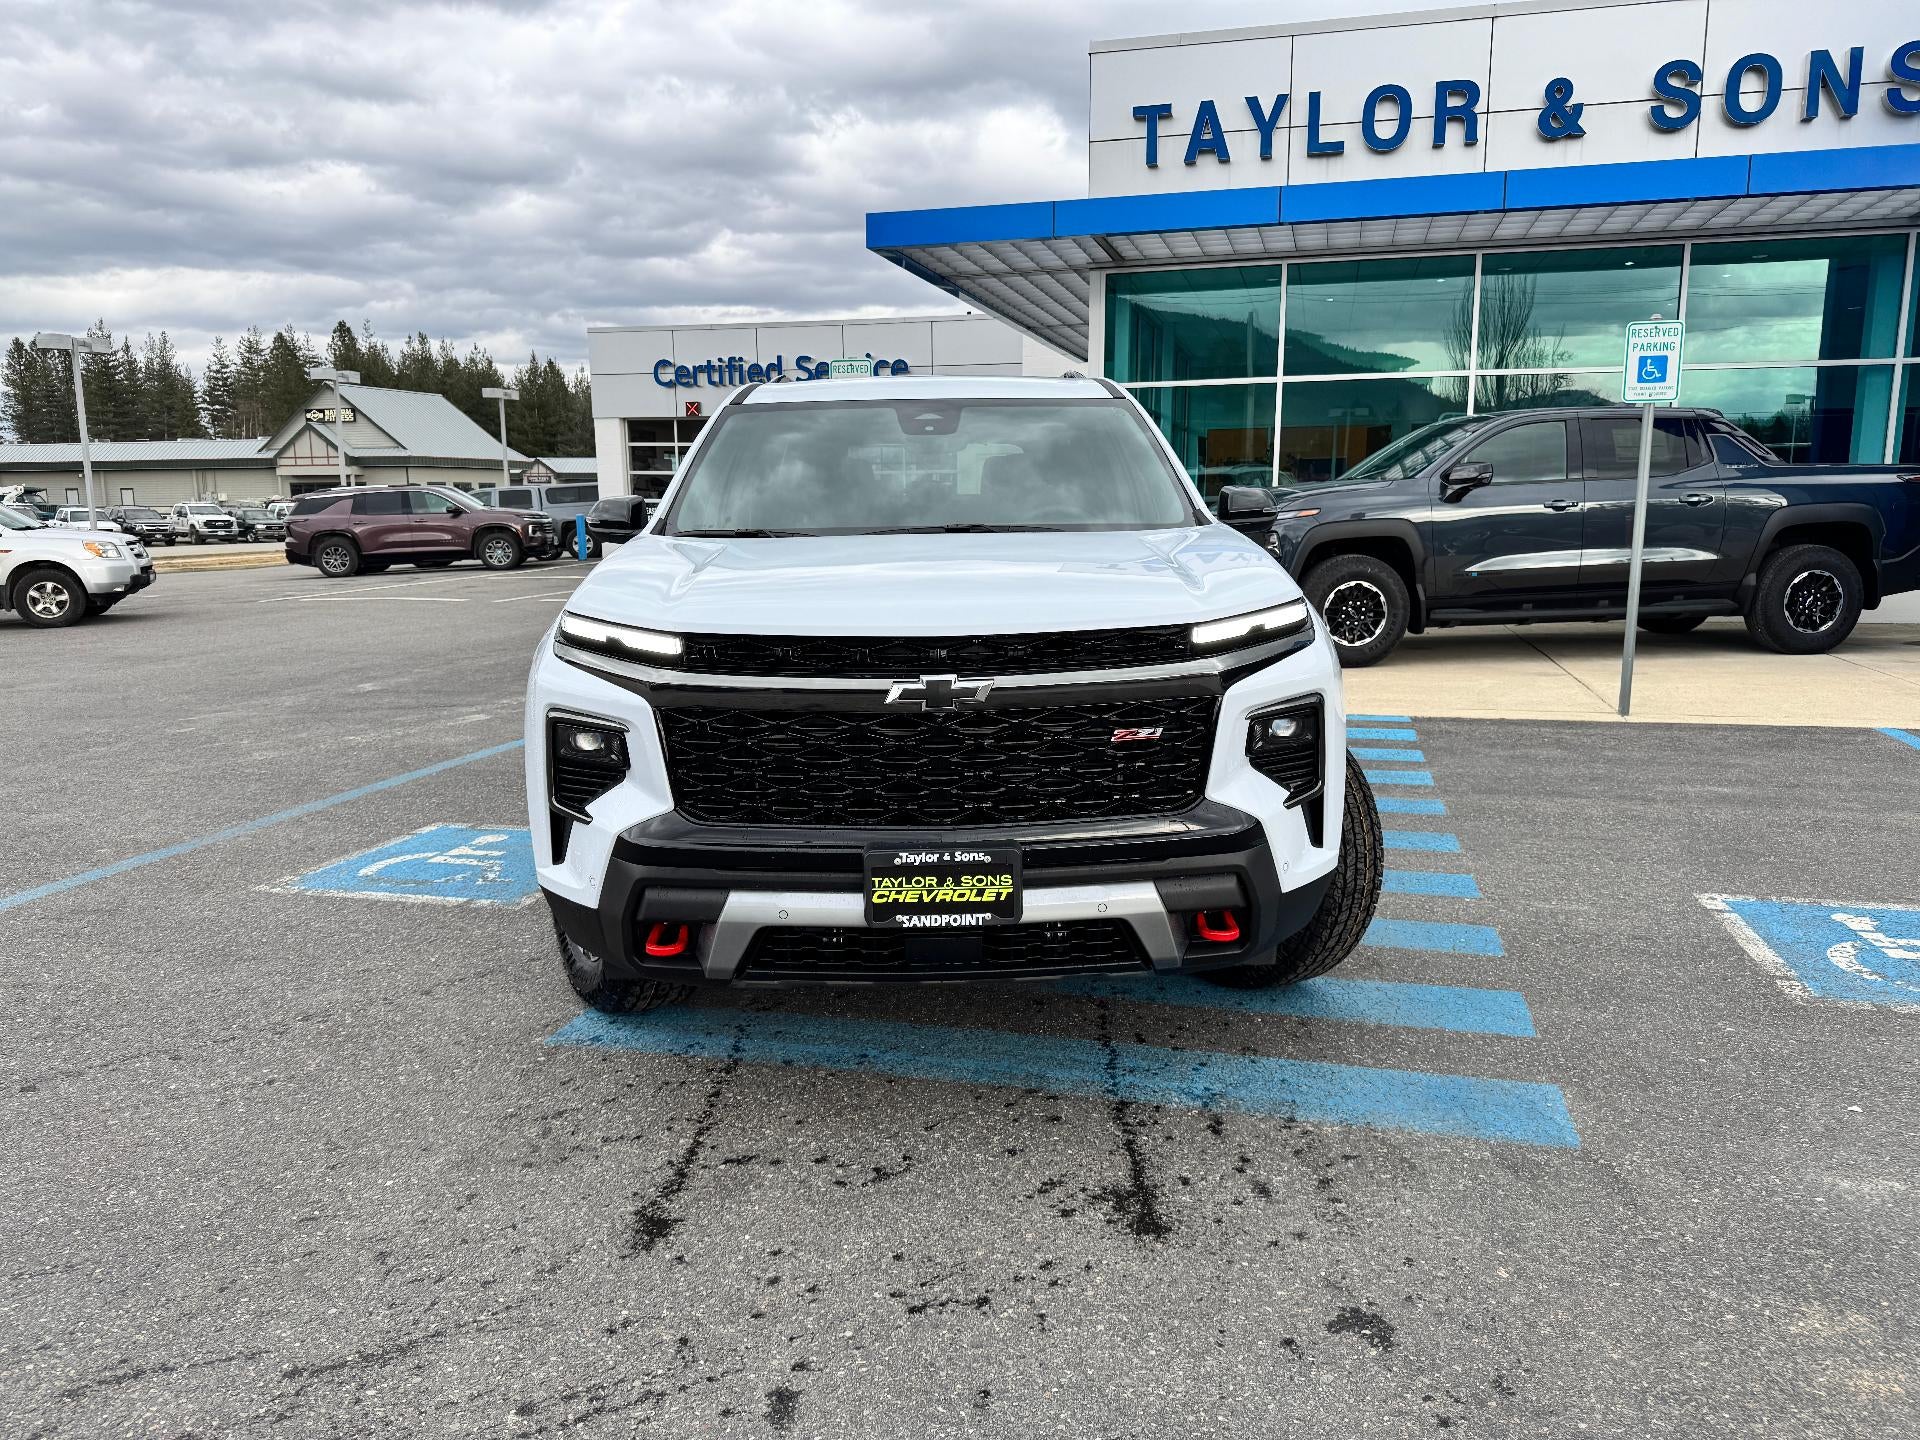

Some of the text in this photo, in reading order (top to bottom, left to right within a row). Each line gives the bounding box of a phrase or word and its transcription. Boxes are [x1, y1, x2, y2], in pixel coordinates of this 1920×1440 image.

[1132, 40, 1920, 168] TAYLOR & SONS
[1631, 327, 1679, 338] RESERVED
[1632, 342, 1676, 352] PARKING
[653, 353, 909, 388] Certified Sece
[833, 364, 869, 374] RESERVED
[899, 851, 985, 865] Taylor & Sons
[872, 875, 1013, 889] TAYLOR & SONS
[872, 888, 1013, 904] CHEVROLET
[902, 913, 984, 927] SANDPOINT
